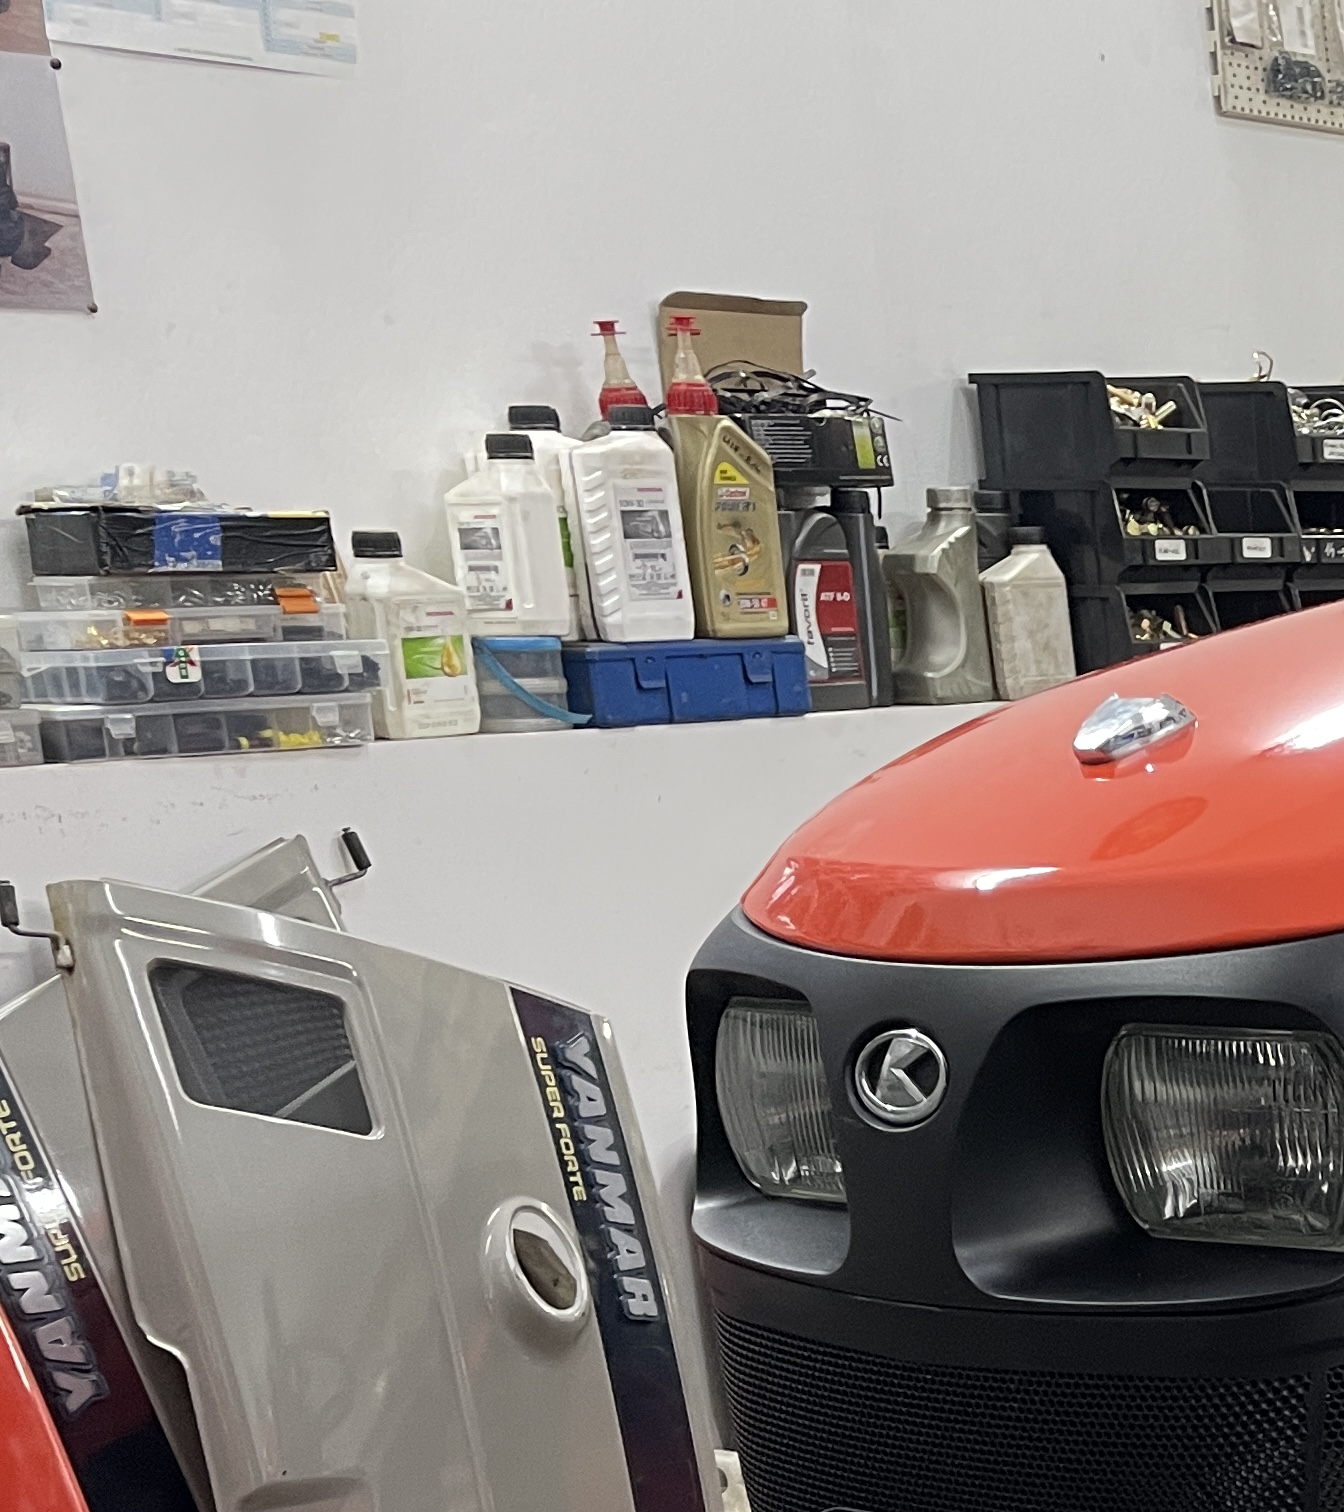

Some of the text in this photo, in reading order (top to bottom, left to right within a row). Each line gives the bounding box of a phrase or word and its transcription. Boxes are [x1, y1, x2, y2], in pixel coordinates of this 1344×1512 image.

[531, 1036, 587, 1202] SUPER FORTE
[562, 1032, 658, 1318] YANMAR
